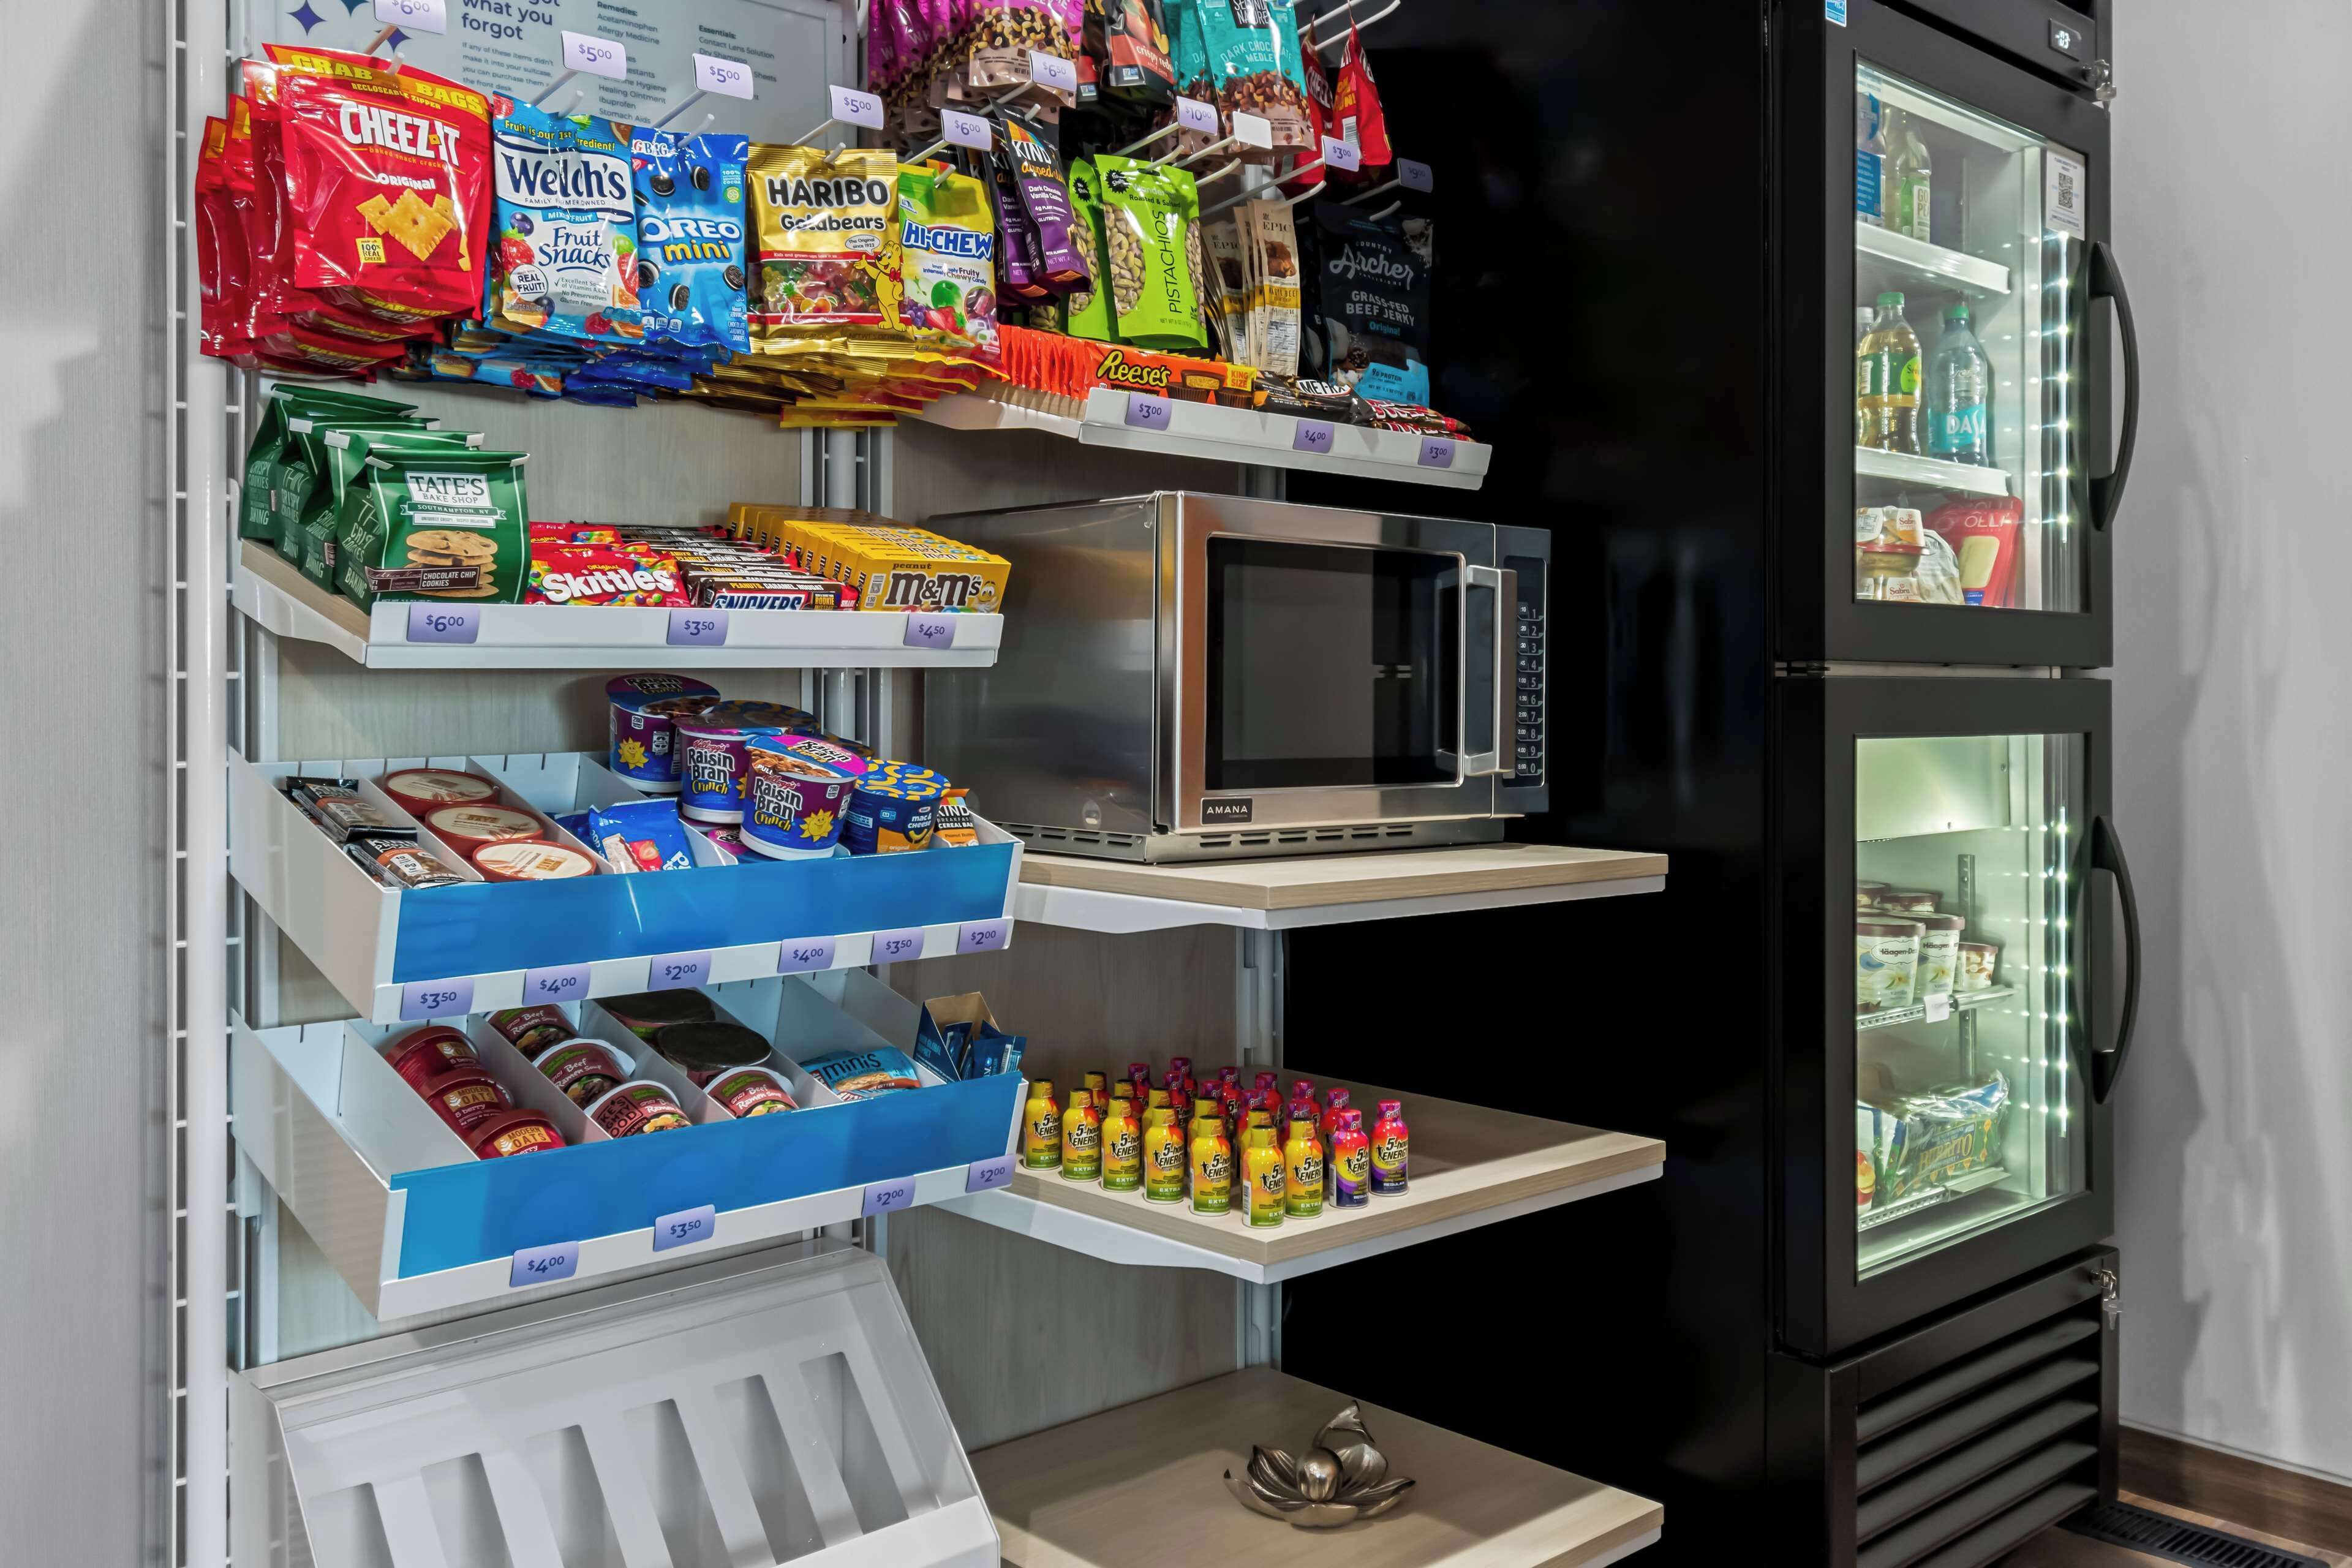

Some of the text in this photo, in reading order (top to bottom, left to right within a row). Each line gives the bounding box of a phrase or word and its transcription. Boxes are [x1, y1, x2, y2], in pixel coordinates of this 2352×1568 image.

[518, 7, 552, 26] you
[597, 1, 638, 17] Remedies:
[461, 13, 524, 40] forgot
[597, 13, 658, 32] Acetaminophen
[597, 25, 660, 45] Allergy Medicine
[699, 24, 736, 40] Essentials:
[699, 37, 775, 59] Contact Lens Solution
[1137, 45, 1159, 65] crispy
[462, 66, 545, 86] you can purchase them
[754, 71, 777, 83] Sheets
[291, 54, 484, 115] GRAB BAGS
[636, 80, 667, 93] Hygiene
[598, 84, 666, 105] Healing Ointment
[410, 96, 442, 110] ZIPPER
[598, 96, 637, 110] Ibuprofen
[598, 108, 651, 124] Stomach Aids
[505, 119, 572, 141] Fruit is our 1st
[1011, 140, 1053, 165] KIND
[500, 151, 627, 201] Welch's
[766, 176, 890, 208] HARIBO
[1028, 186, 1044, 194] Dark
[1129, 194, 1155, 203] Roasted
[1162, 200, 1181, 208] Salted
[570, 213, 594, 222] FRUIT
[780, 213, 886, 232] Goldbears
[639, 216, 740, 243] OREO
[1263, 221, 1292, 232] EPIC
[552, 226, 603, 249] Fruit
[903, 222, 993, 260] HI-CHEW
[538, 243, 611, 269] Snacks
[663, 239, 730, 262] mini
[1152, 209, 1182, 314] PISTACHIOS
[1329, 242, 1414, 291] Archer
[518, 273, 541, 284] REAL
[946, 272, 972, 283] Chewy
[972, 277, 987, 285] Candy
[959, 267, 980, 277] Fruity
[516, 282, 546, 295] FRUIT!
[570, 291, 608, 302] Preservatives
[560, 296, 579, 305] Gluten
[1351, 290, 1409, 313] GRASS-FED
[1346, 303, 1415, 326] BEEF JERKY
[1368, 320, 1401, 336] Original
[1095, 349, 1171, 387] Reese's
[1231, 370, 1248, 380] KING
[1231, 378, 1248, 388] SIZE
[409, 475, 485, 496] TATE'S
[422, 493, 479, 504] BAKE SHOP
[892, 562, 932, 571] peanut
[344, 566, 368, 601] BAKING
[423, 571, 459, 581] CHOCOLATE
[541, 568, 676, 603] Skittles
[884, 571, 981, 606] m&m's
[815, 597, 834, 606] ROOKIE
[1531, 677, 1537, 687] 5
[1531, 694, 1536, 705] 6
[1531, 711, 1536, 722] 7
[1531, 728, 1536, 739] 8
[692, 739, 726, 752] Kellogg's
[1530, 745, 1536, 756] 9
[687, 747, 735, 772] Raisin
[690, 764, 729, 785] Bran
[757, 764, 774, 775] PULL
[1530, 763, 1536, 774] 0
[692, 780, 729, 795] Crunch
[753, 777, 803, 810] Raisin
[755, 795, 794, 820] Bran
[937, 805, 970, 817] KIND
[1206, 805, 1248, 815] AMANA
[754, 810, 791, 832] Crunch
[521, 1010, 545, 1021] Beef
[566, 1058, 587, 1072] Beef
[823, 1054, 882, 1078] minis
[555, 1068, 584, 1088] Ramen
[457, 1086, 490, 1096] MODERN
[462, 1093, 496, 1105] OATS
[462, 1104, 486, 1115] berry
[507, 1126, 542, 1139] MODERN
[514, 1133, 547, 1148] OATS
